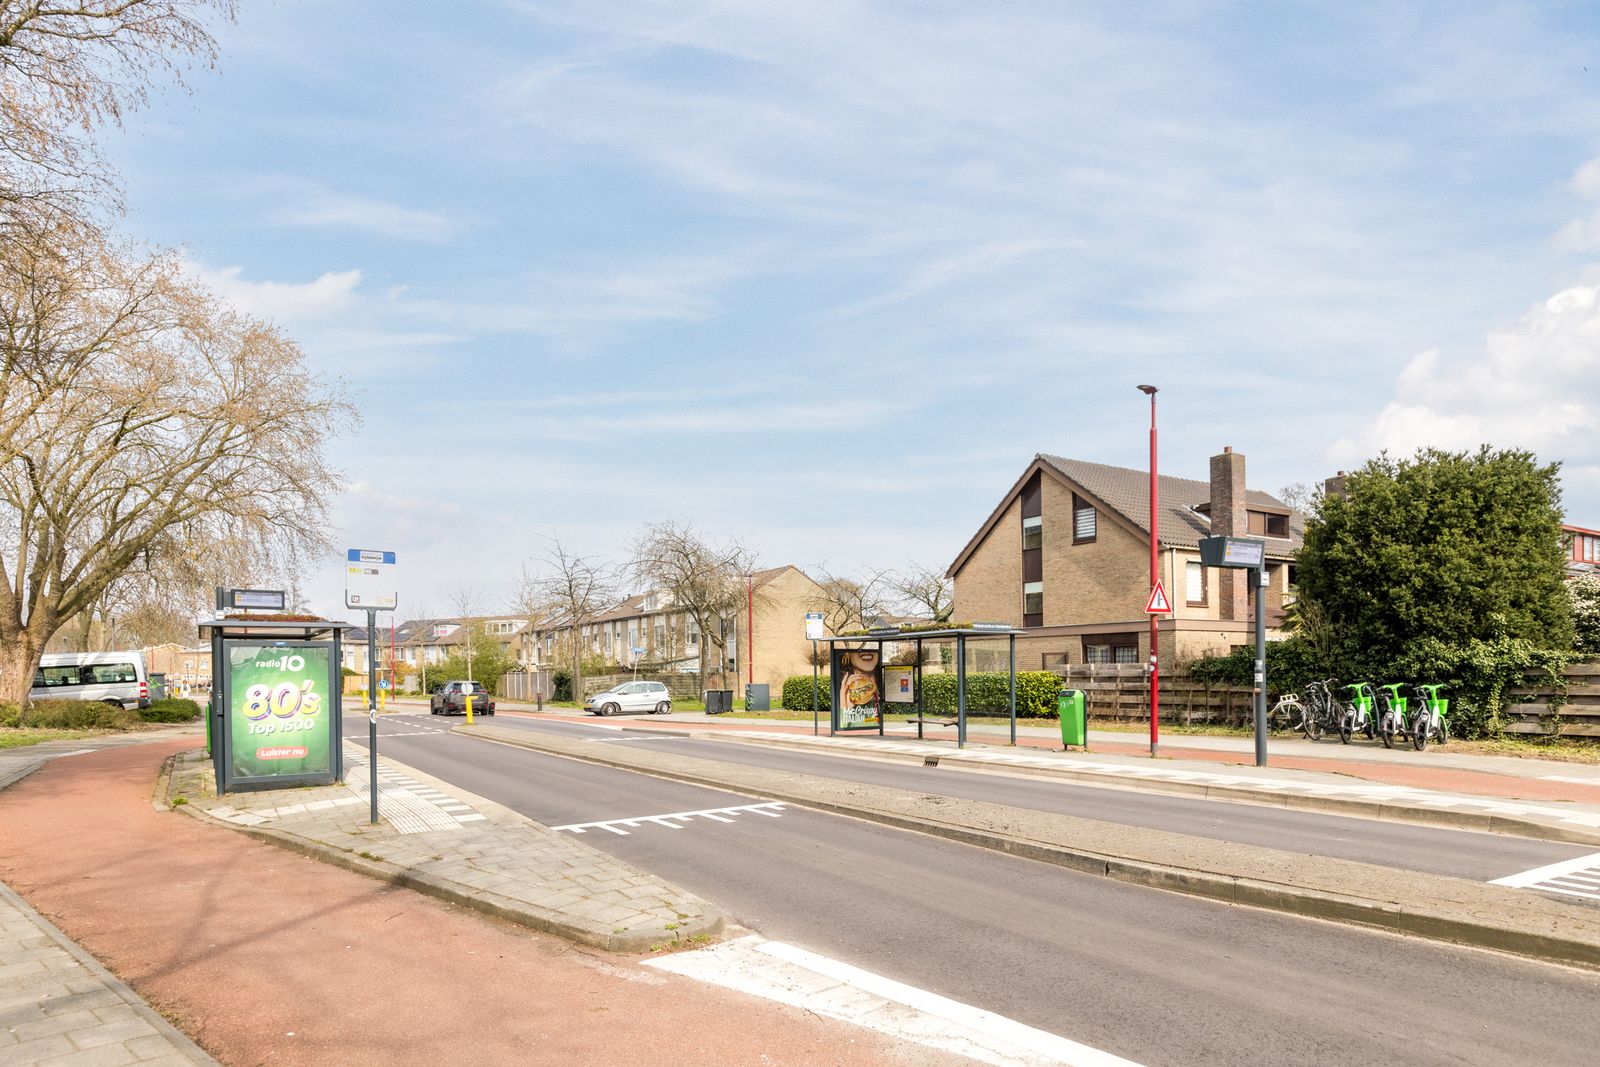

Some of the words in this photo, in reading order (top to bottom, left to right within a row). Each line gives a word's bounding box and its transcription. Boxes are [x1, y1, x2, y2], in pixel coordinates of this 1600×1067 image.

[255, 660, 281, 668] radio
[280, 655, 305, 672] 10
[242, 679, 322, 720] 80's
[247, 721, 276, 736] Top
[279, 718, 316, 732] 1500
[261, 748, 291, 757] Luister
[292, 748, 305, 756] nu
